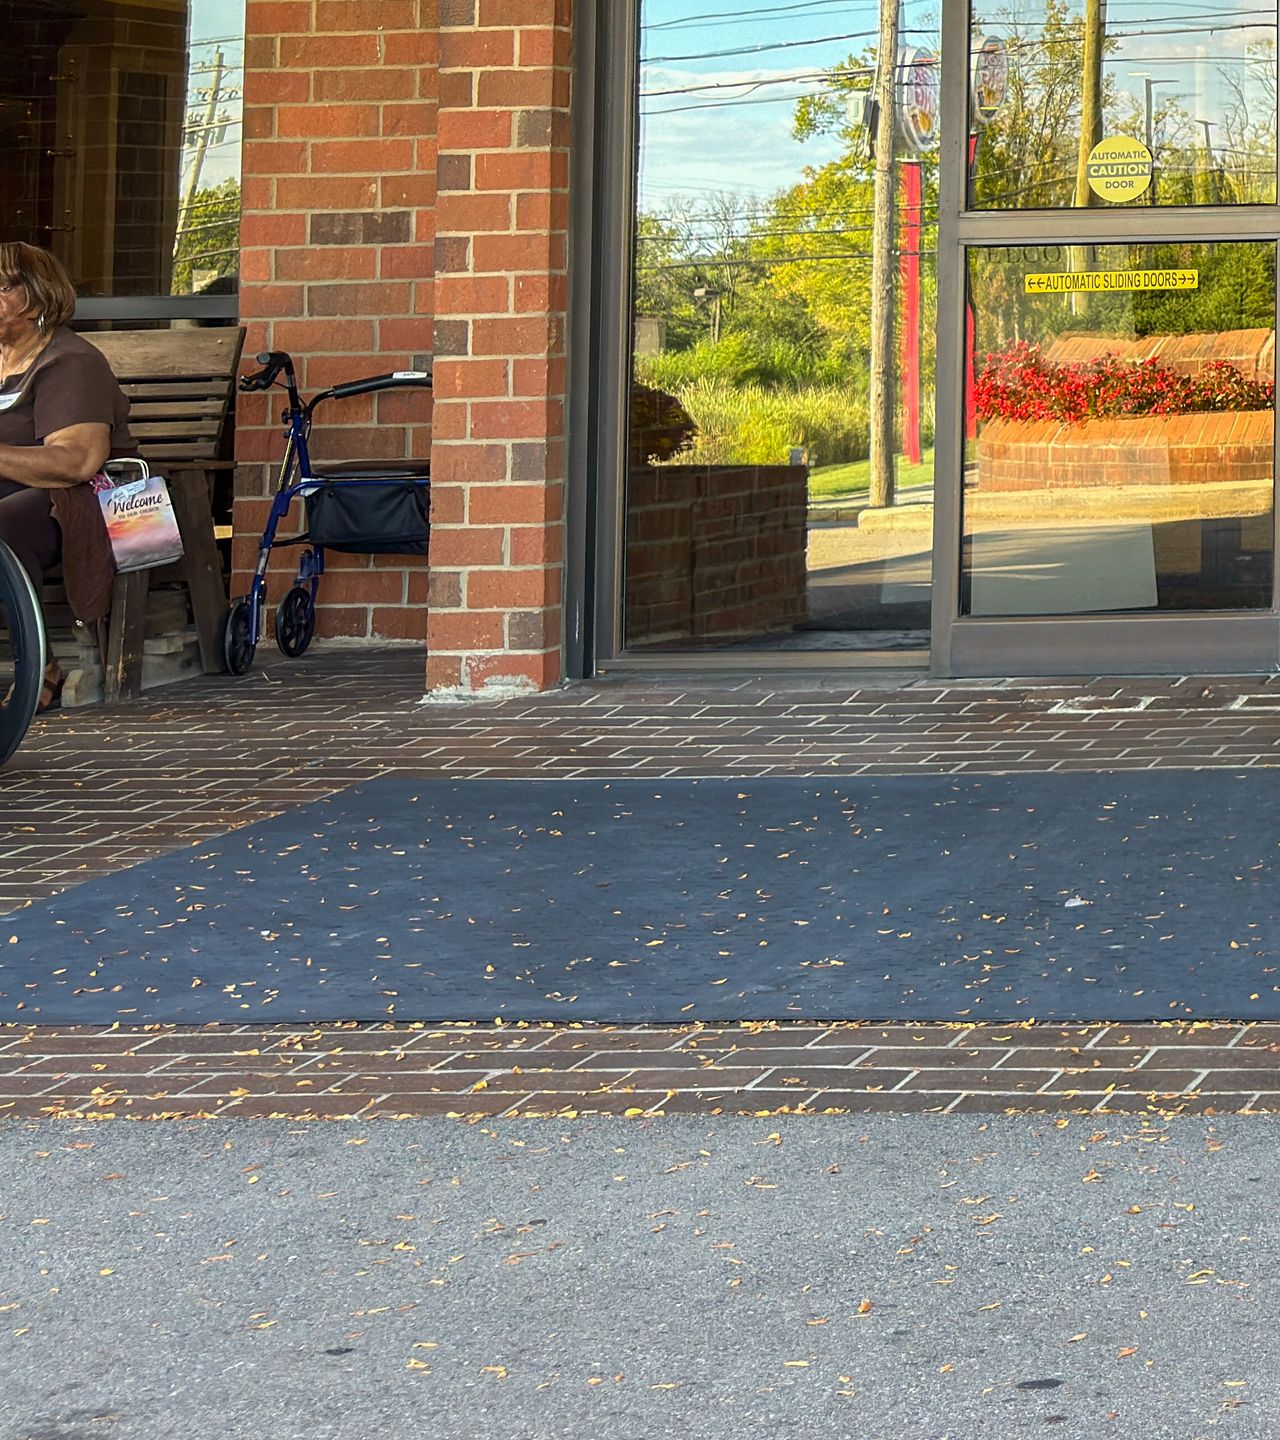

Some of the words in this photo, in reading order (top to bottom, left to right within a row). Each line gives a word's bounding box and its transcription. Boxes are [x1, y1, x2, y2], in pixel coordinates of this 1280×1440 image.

[1091, 150, 1147, 160] AUTOMATIC
[1090, 163, 1149, 176] CAUTION
[1105, 180, 1135, 189] DOOR
[1045, 274, 1101, 290] AUTOMATIC
[1103, 273, 1141, 289] SLIDING
[1143, 272, 1178, 287] DOORS
